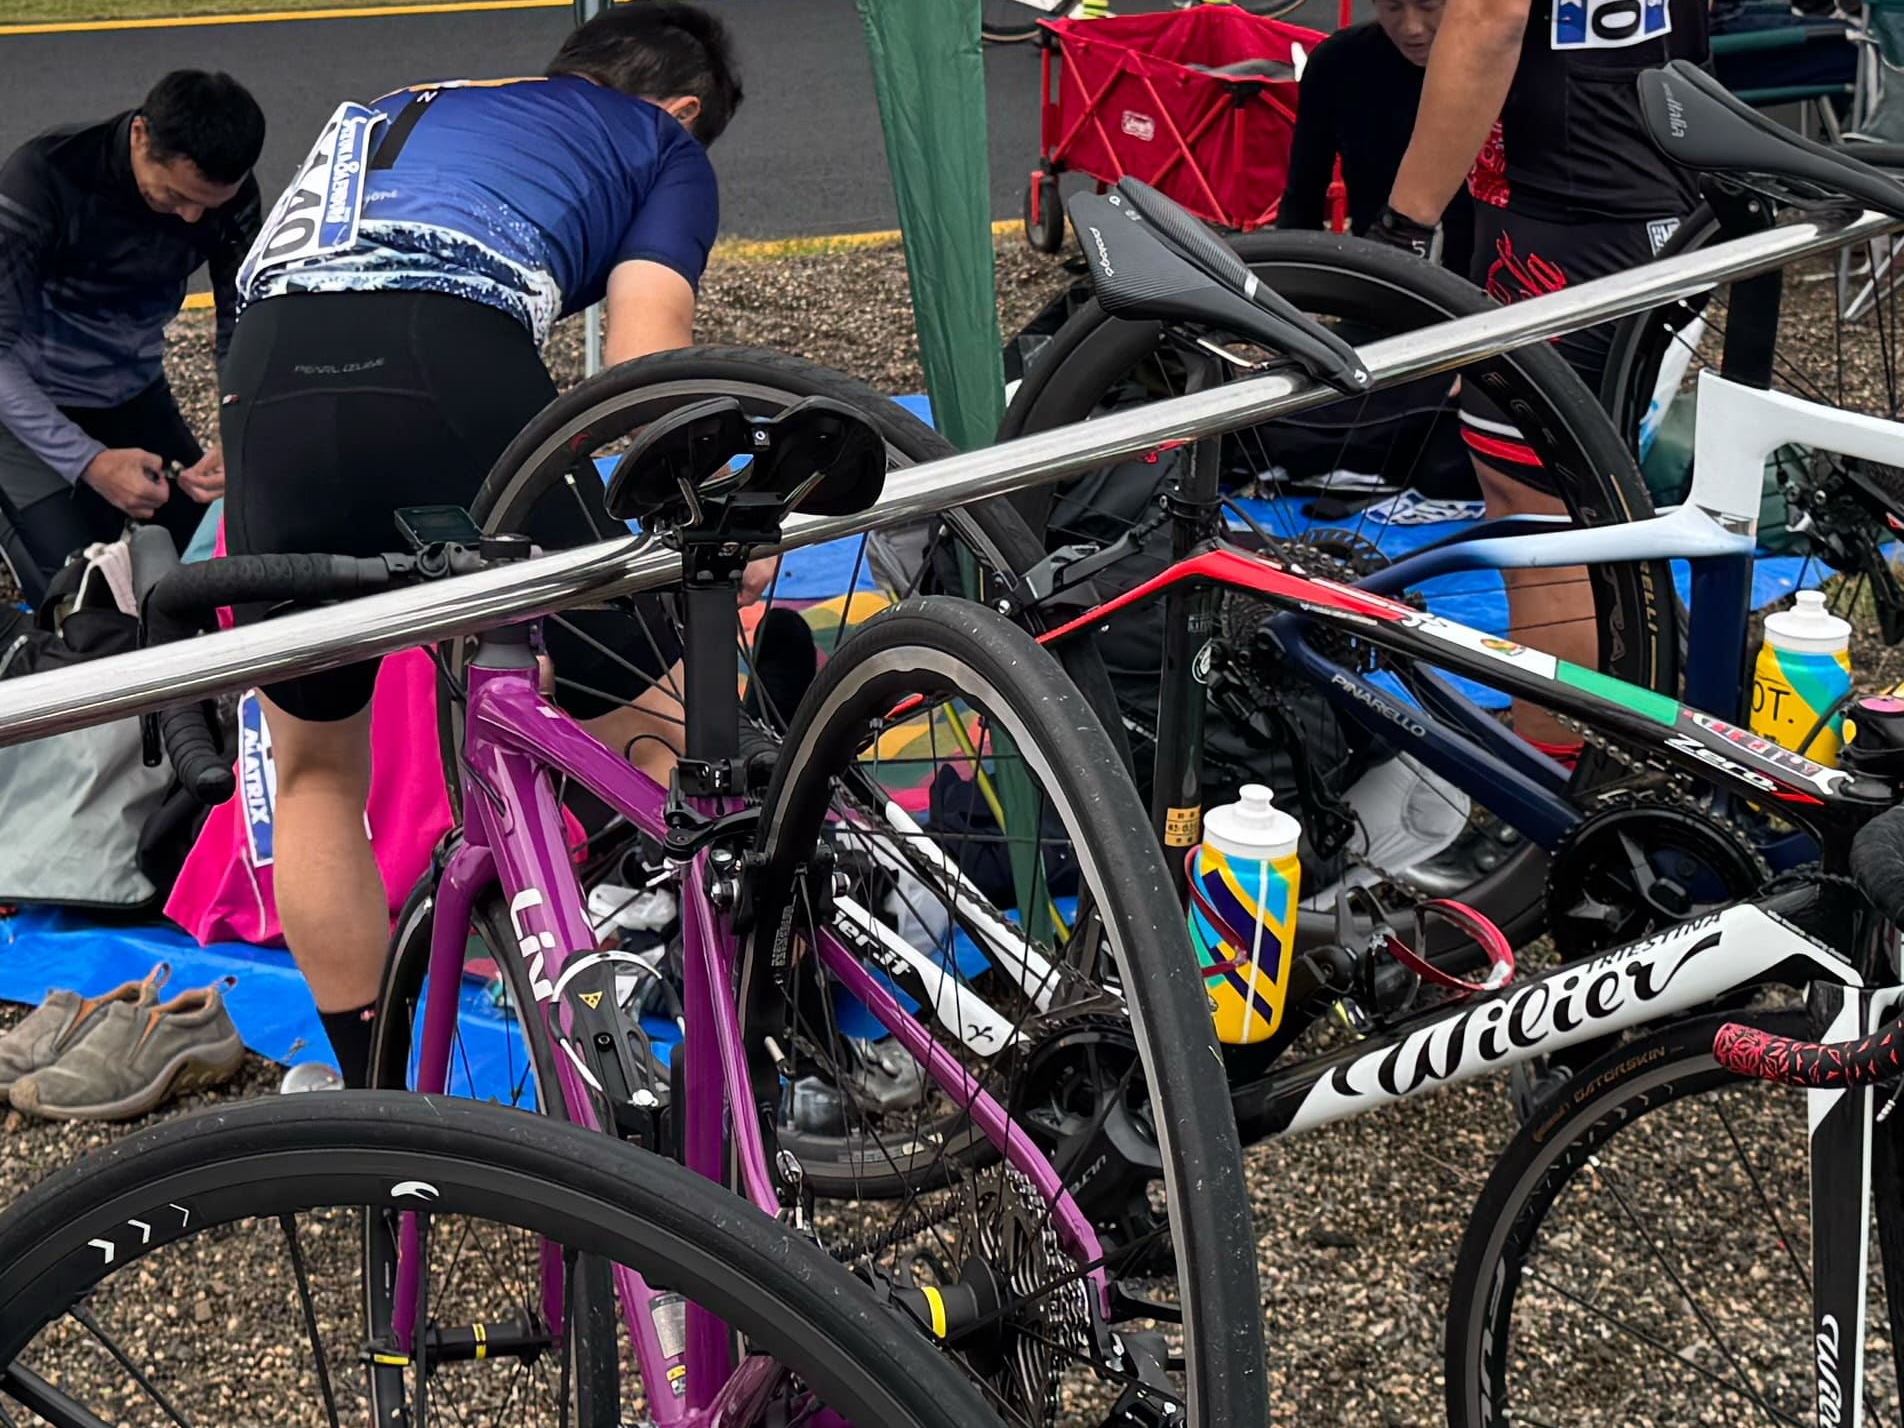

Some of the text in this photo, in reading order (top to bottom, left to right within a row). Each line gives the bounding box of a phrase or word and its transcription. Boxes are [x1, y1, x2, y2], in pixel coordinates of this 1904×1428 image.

[1331, 674, 1426, 738] PINARELLO
[1587, 910, 1724, 974] TRIESTINA
[1332, 931, 1724, 1098] Wilier
[1574, 1047, 1666, 1102] GATORSKIN
